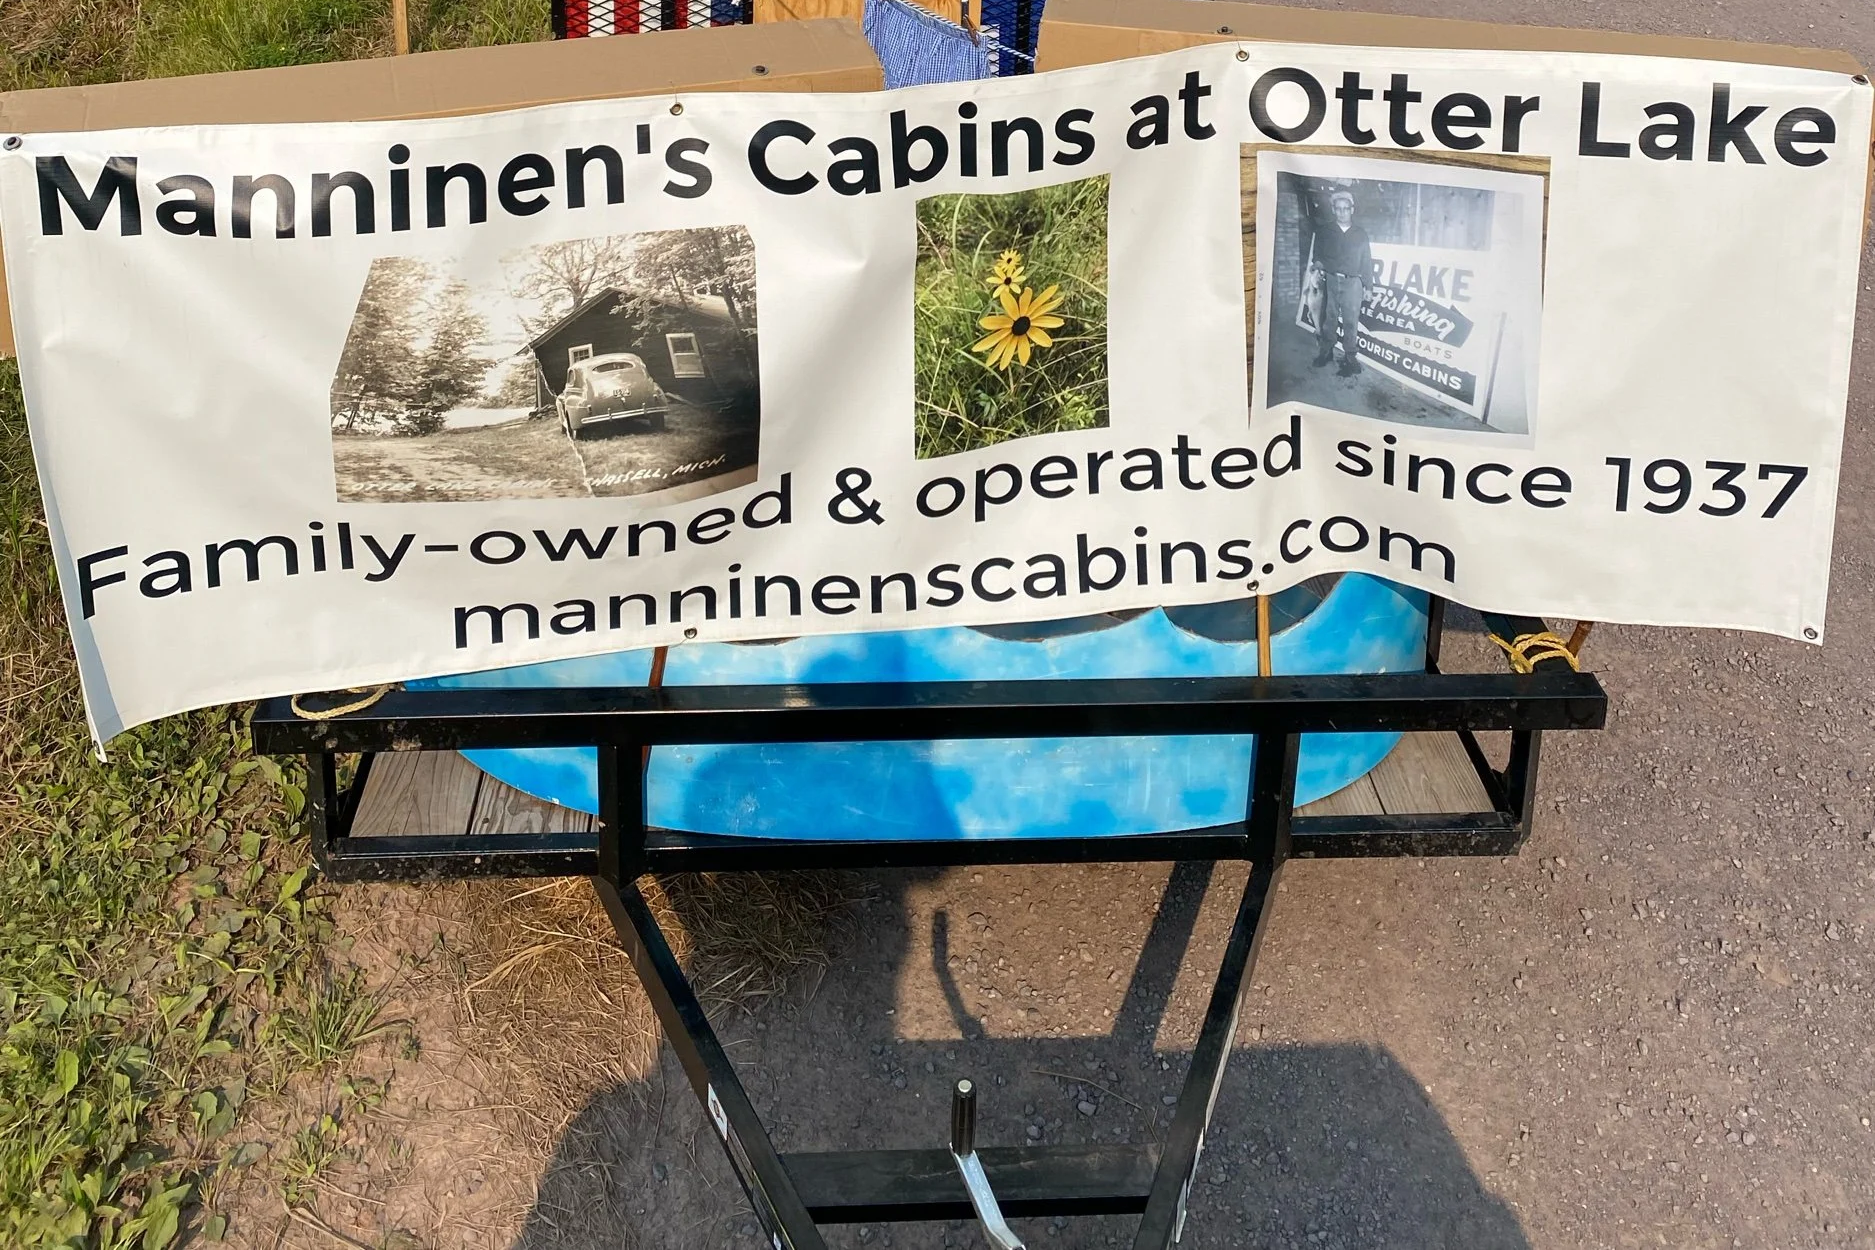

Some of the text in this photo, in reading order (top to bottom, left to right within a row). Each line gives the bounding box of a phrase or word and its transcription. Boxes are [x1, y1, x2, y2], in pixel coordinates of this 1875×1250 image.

[36, 67, 1836, 239] Manninen's Cabins at Otter Lake
[1388, 260, 1474, 303] LAKE
[1370, 287, 1456, 342] Fishing
[1375, 312, 1416, 332] AREA
[1404, 337, 1454, 359] BOATS
[1402, 357, 1463, 390] CABINS
[77, 414, 1809, 621] Family-owned & operated since 1937
[454, 515, 1456, 649] manninenscabins.com
